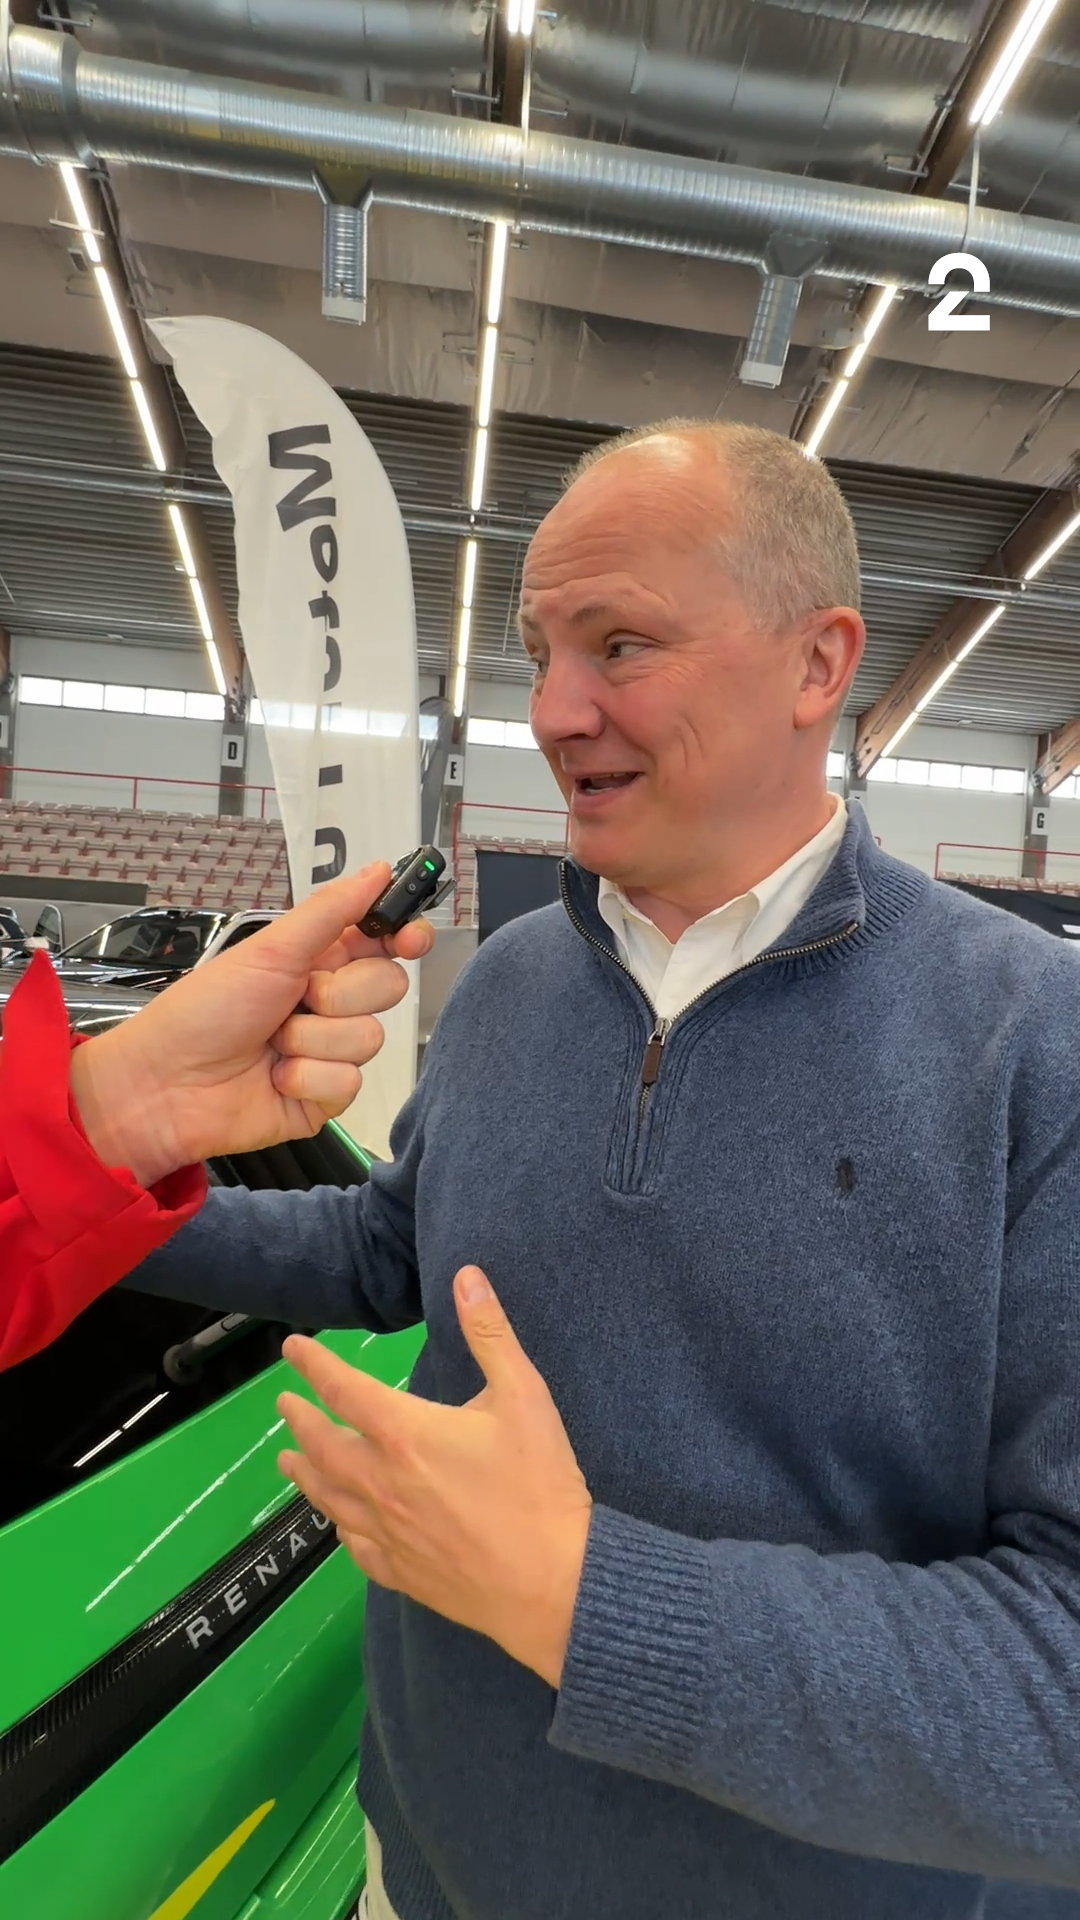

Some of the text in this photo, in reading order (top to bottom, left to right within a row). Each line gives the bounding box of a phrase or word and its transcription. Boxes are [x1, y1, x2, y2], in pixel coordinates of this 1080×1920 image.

[228, 741, 238, 760] D
[450, 761, 458, 780] E
[1036, 812, 1045, 829] G
